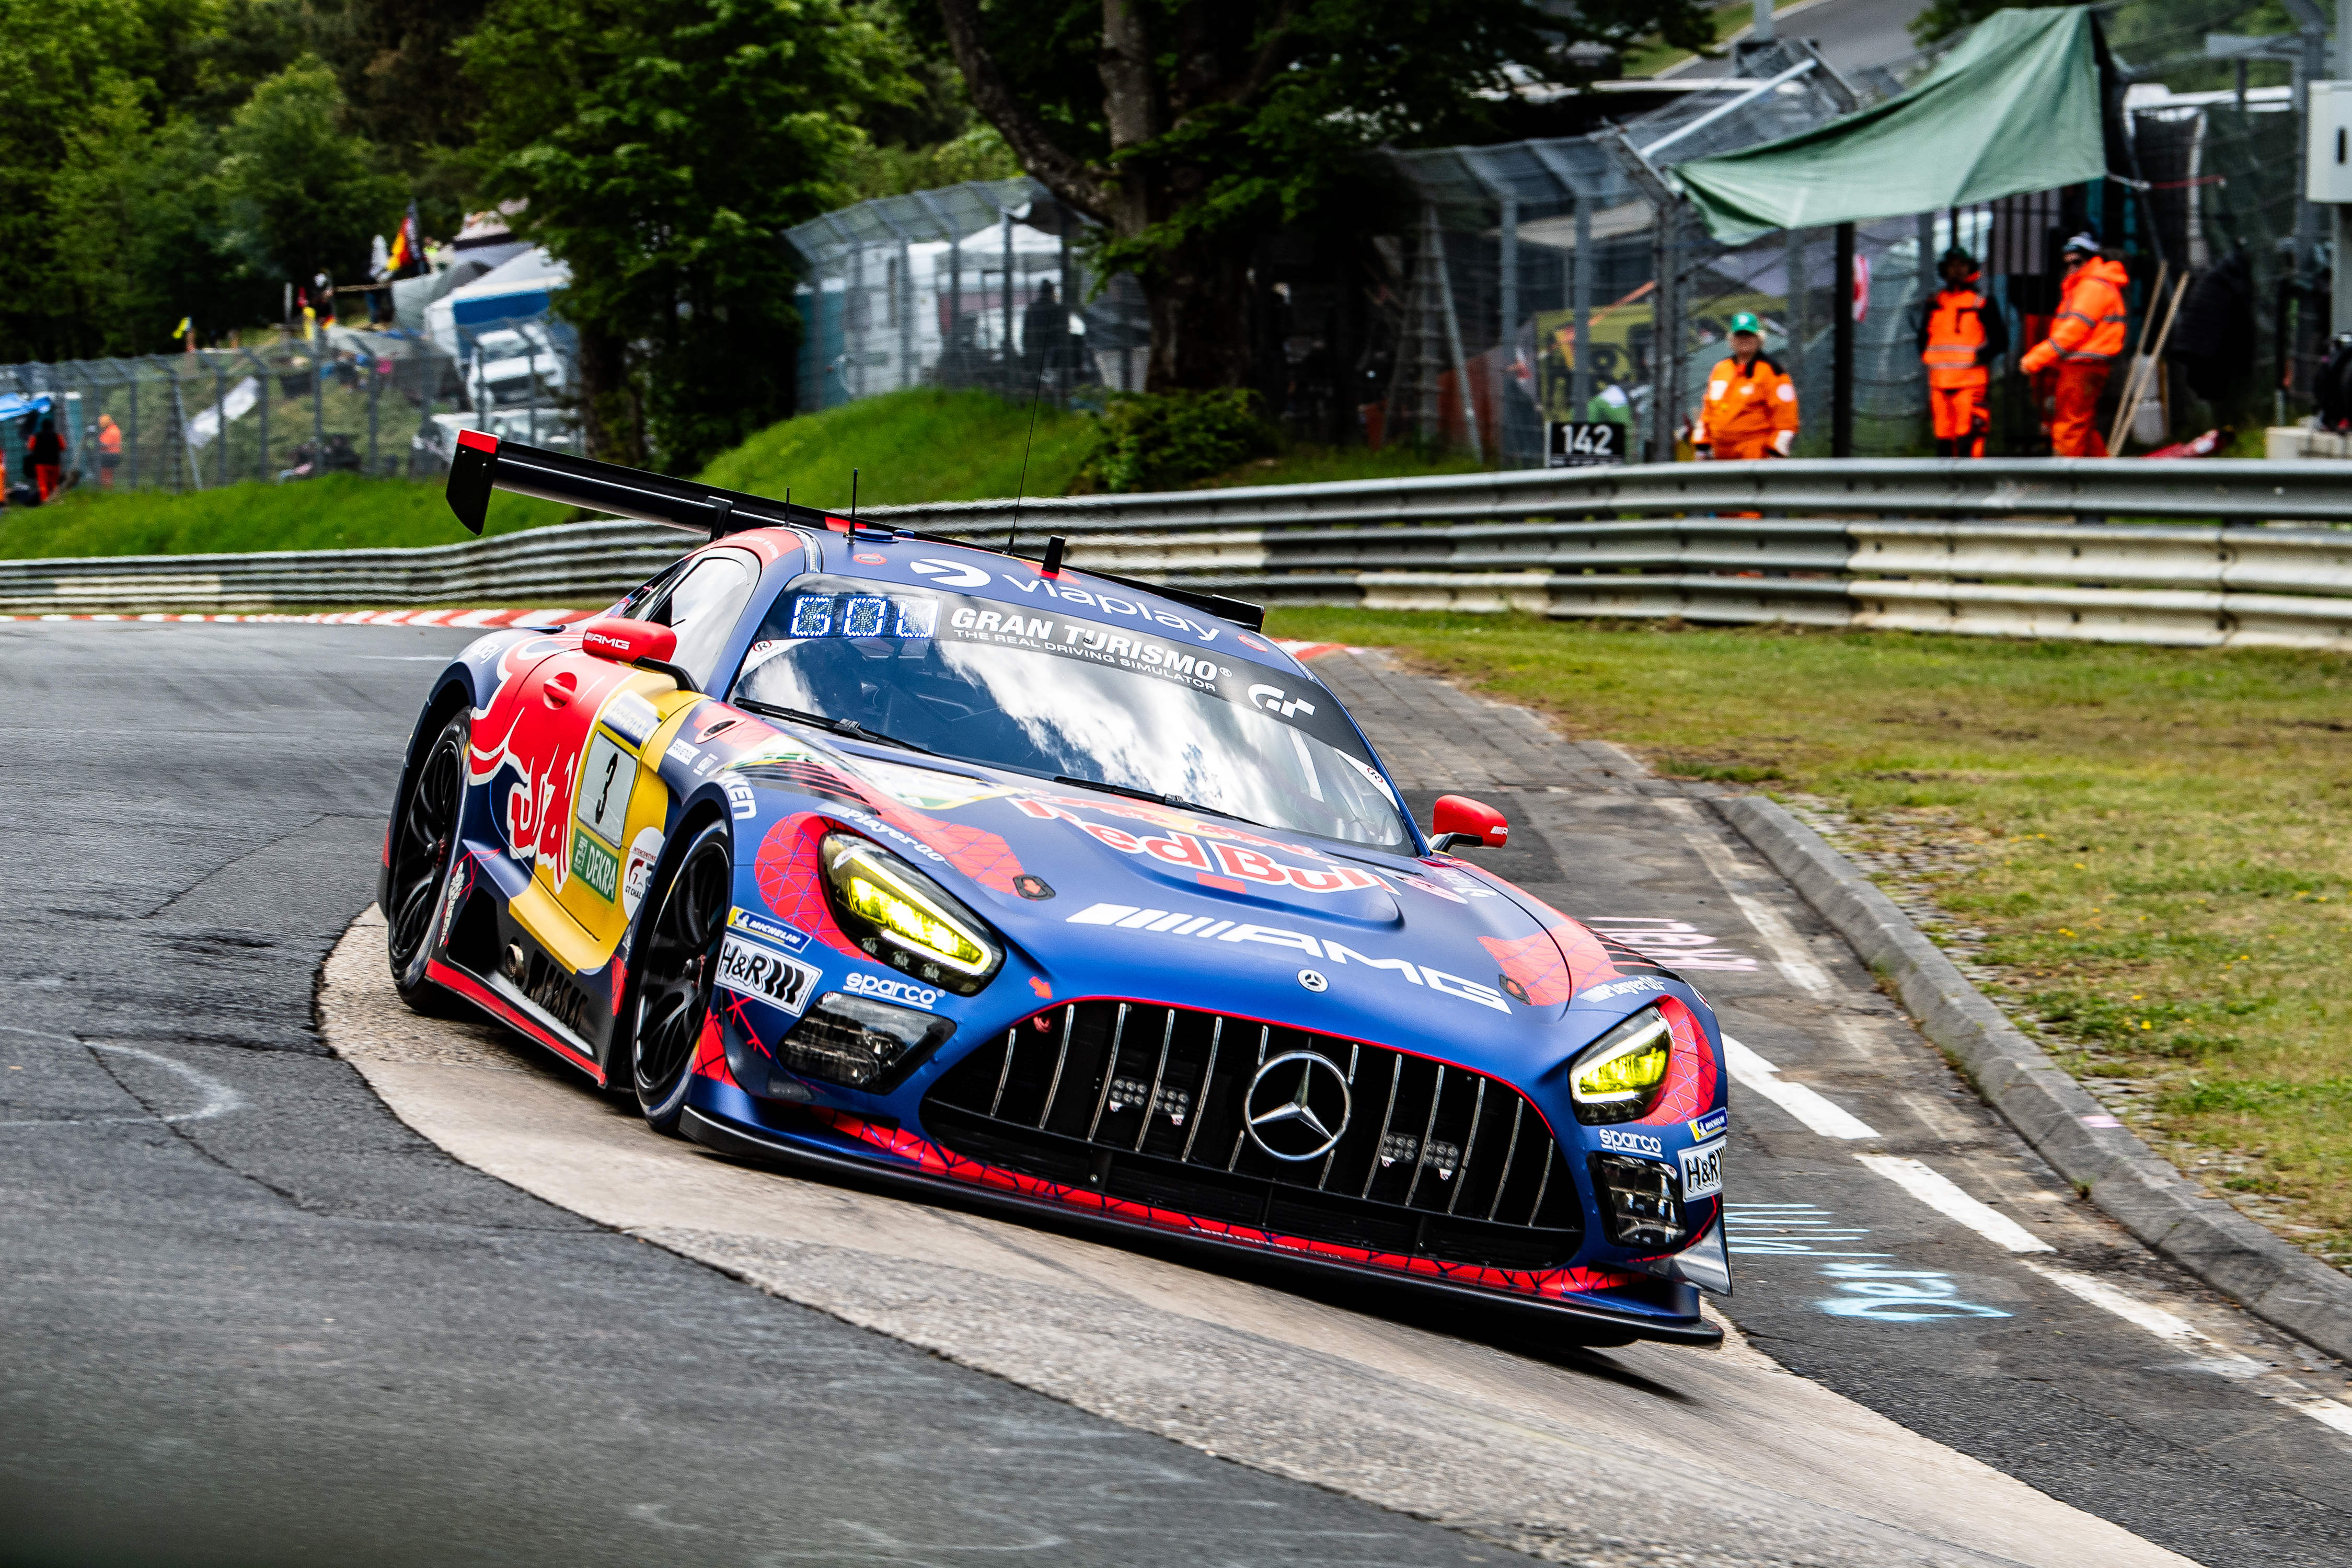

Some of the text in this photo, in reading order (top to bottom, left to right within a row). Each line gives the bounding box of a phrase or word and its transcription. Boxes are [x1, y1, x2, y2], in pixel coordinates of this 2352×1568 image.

[1561, 424, 1612, 455] 142
[951, 607, 1054, 640] GRAN
[1002, 574, 1220, 640] viaplay
[591, 633, 630, 650] AMG
[954, 629, 1216, 692] THE REAL DRIVING SIMULATOR
[595, 751, 619, 825] 3
[585, 845, 617, 899] DEKRA
[748, 920, 801, 944] MICHELIN
[719, 943, 767, 985] H&R
[1217, 924, 1513, 1015] AMG
[846, 972, 937, 1005] sparco
[1599, 1128, 1662, 1153] sparco
[1684, 1151, 1720, 1189] H&R
